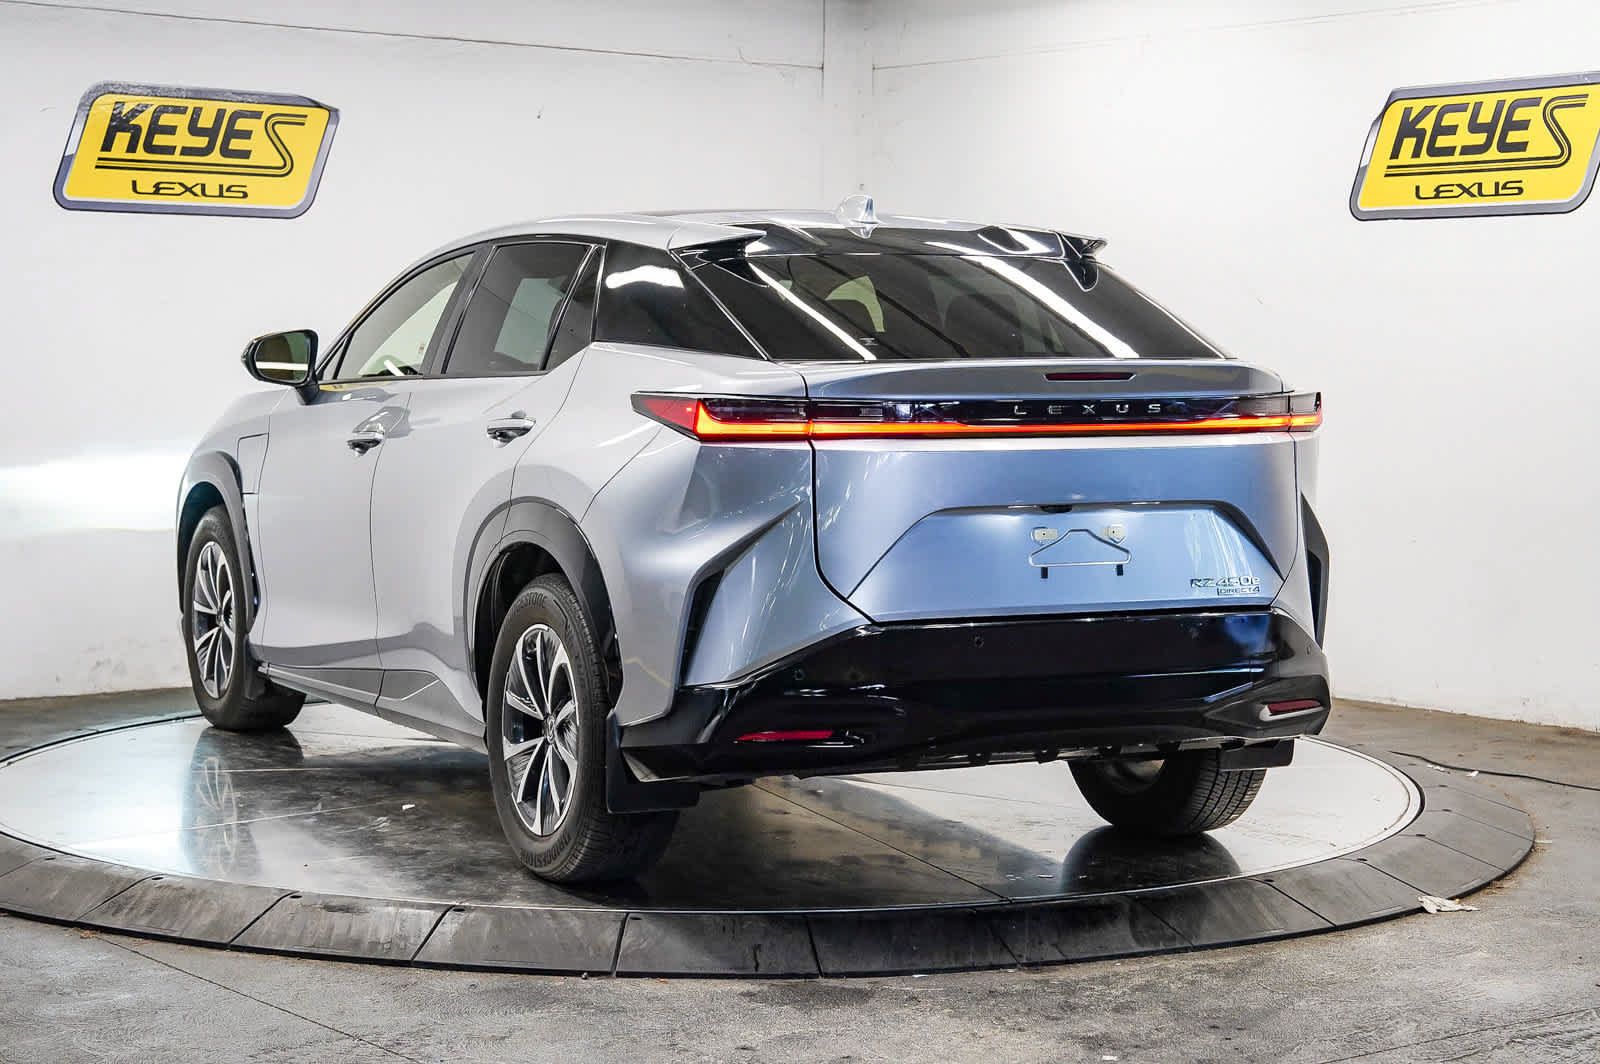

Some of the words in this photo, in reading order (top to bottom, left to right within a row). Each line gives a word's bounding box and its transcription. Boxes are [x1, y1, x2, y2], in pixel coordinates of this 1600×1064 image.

[97, 101, 308, 177] KEYES
[1386, 94, 1590, 172] KEYES
[131, 180, 249, 199] LEXUS
[1415, 180, 1525, 200] LEXUS
[1013, 404, 1161, 415] LEXUS
